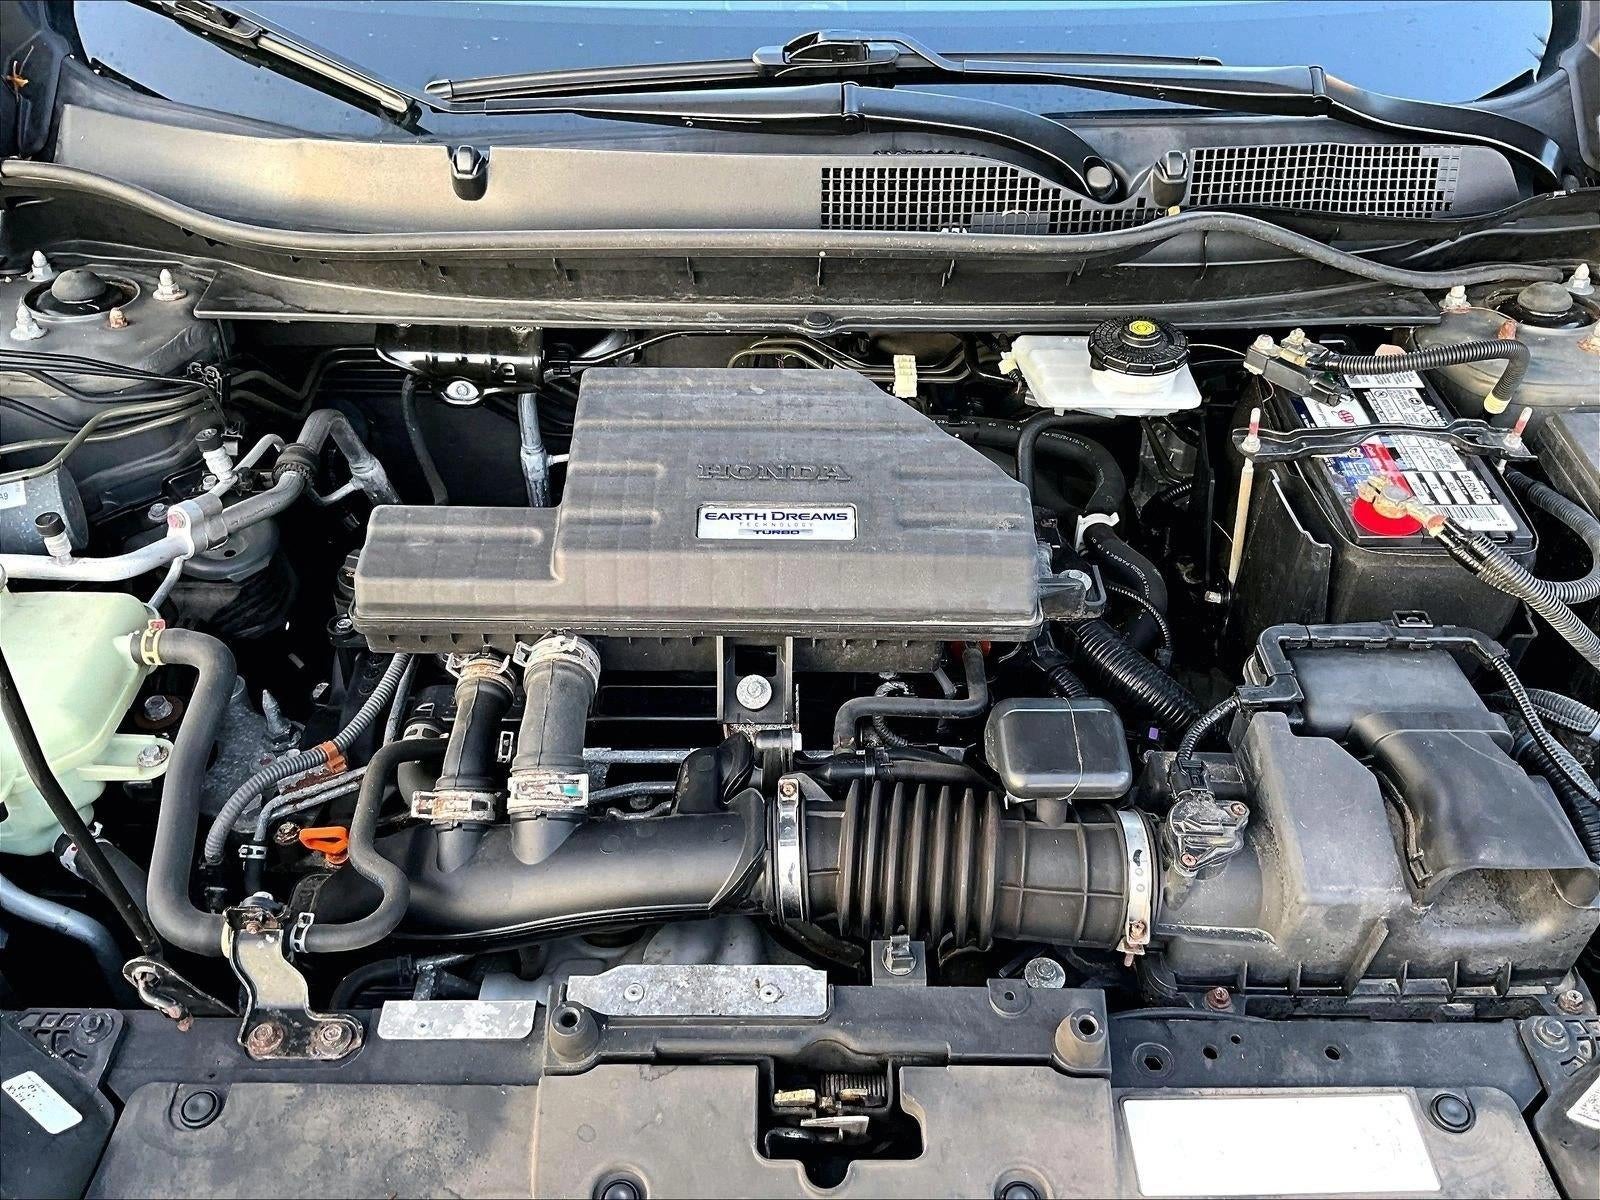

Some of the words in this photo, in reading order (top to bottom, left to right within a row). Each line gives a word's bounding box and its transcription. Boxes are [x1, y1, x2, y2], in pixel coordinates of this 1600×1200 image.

[697, 463, 852, 481] HONDA
[704, 512, 767, 521] EARTH
[771, 511, 848, 521] DREAMS
